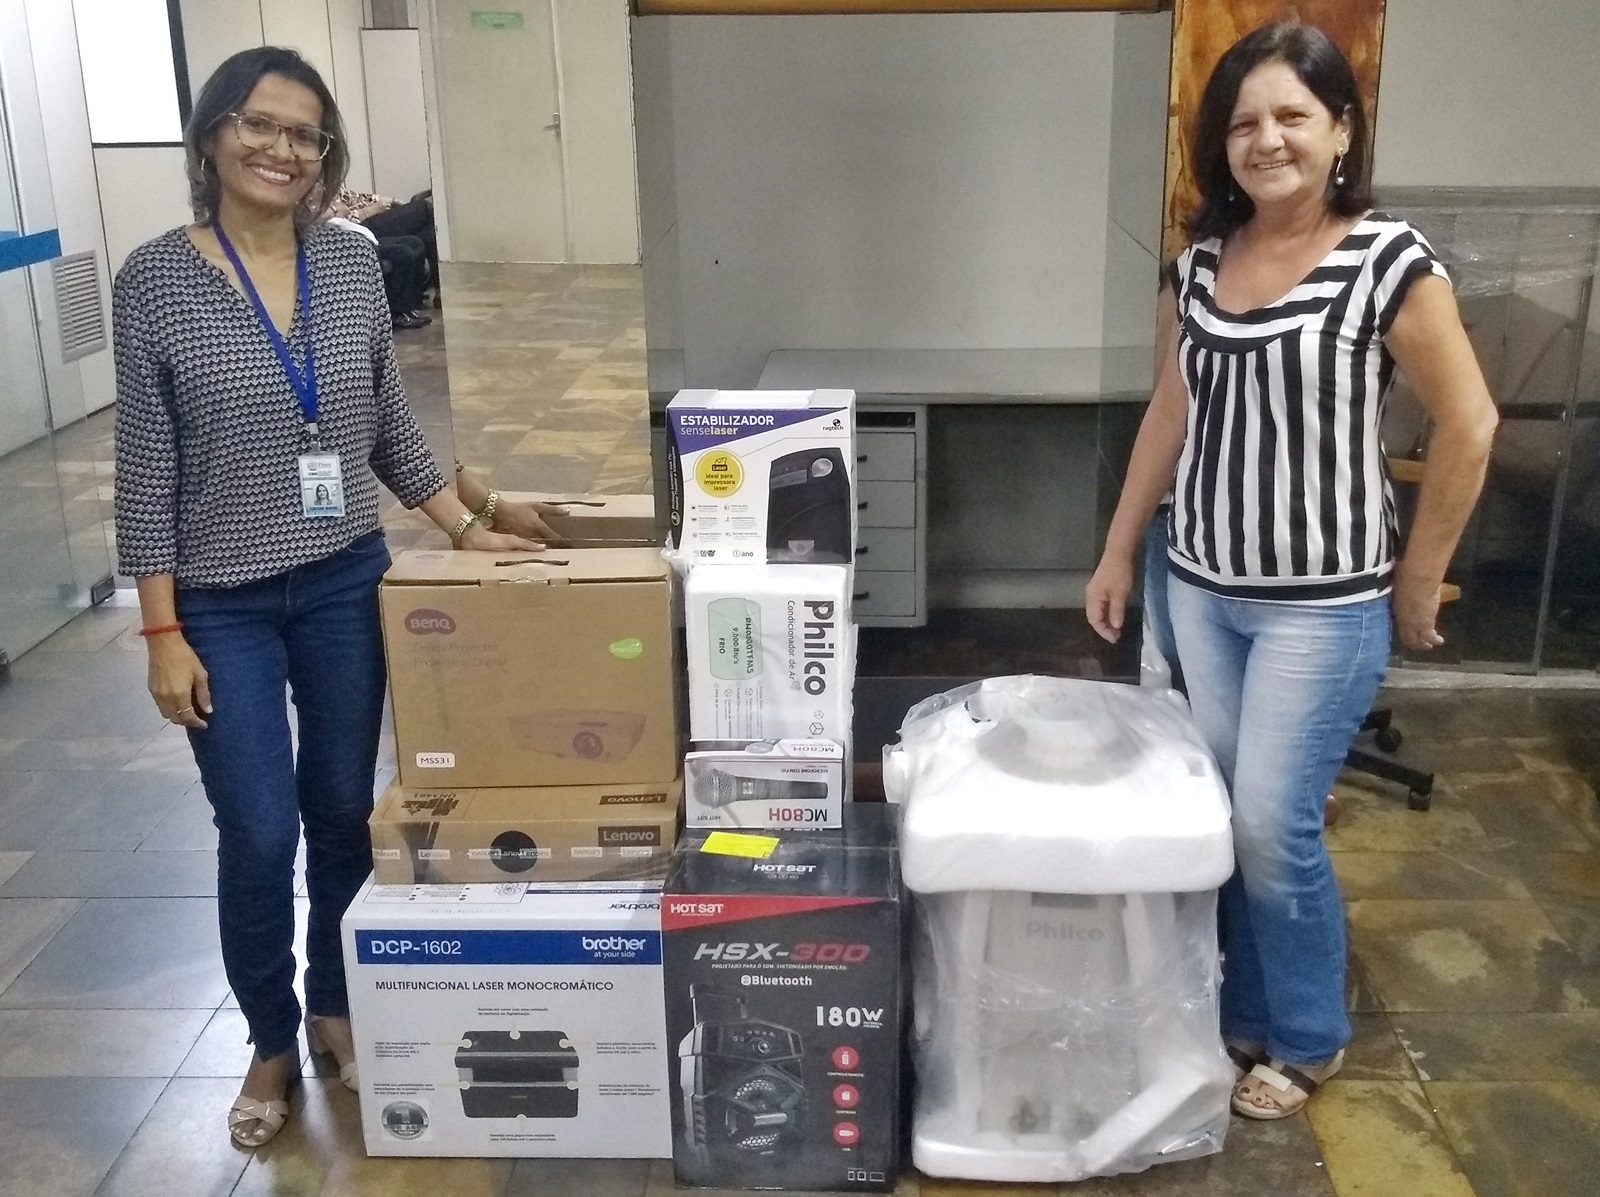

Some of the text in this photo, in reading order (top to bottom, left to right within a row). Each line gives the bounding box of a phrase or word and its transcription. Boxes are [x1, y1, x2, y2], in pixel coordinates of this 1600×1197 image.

[680, 415, 774, 426] ESTABILIZADOR
[680, 426, 738, 436] senselaser
[410, 618, 451, 630] BenQ
[787, 600, 796, 681] Condicionador de Ar
[803, 600, 834, 696] Philco
[420, 757, 451, 765] MS531
[607, 795, 662, 804] Lenovo
[768, 807, 829, 823] MC80H
[603, 830, 655, 841] Lenovo
[753, 864, 786, 873] HOT
[670, 903, 697, 914] HOT
[1025, 920, 1105, 941] Philco
[371, 940, 462, 954] DCP-1602
[582, 936, 646, 951] brother
[693, 942, 871, 962] HSX-300
[375, 979, 614, 991] MULTIFUNCIONAL LASER MONOCROMÁTICO
[752, 975, 813, 986] Bluetooth
